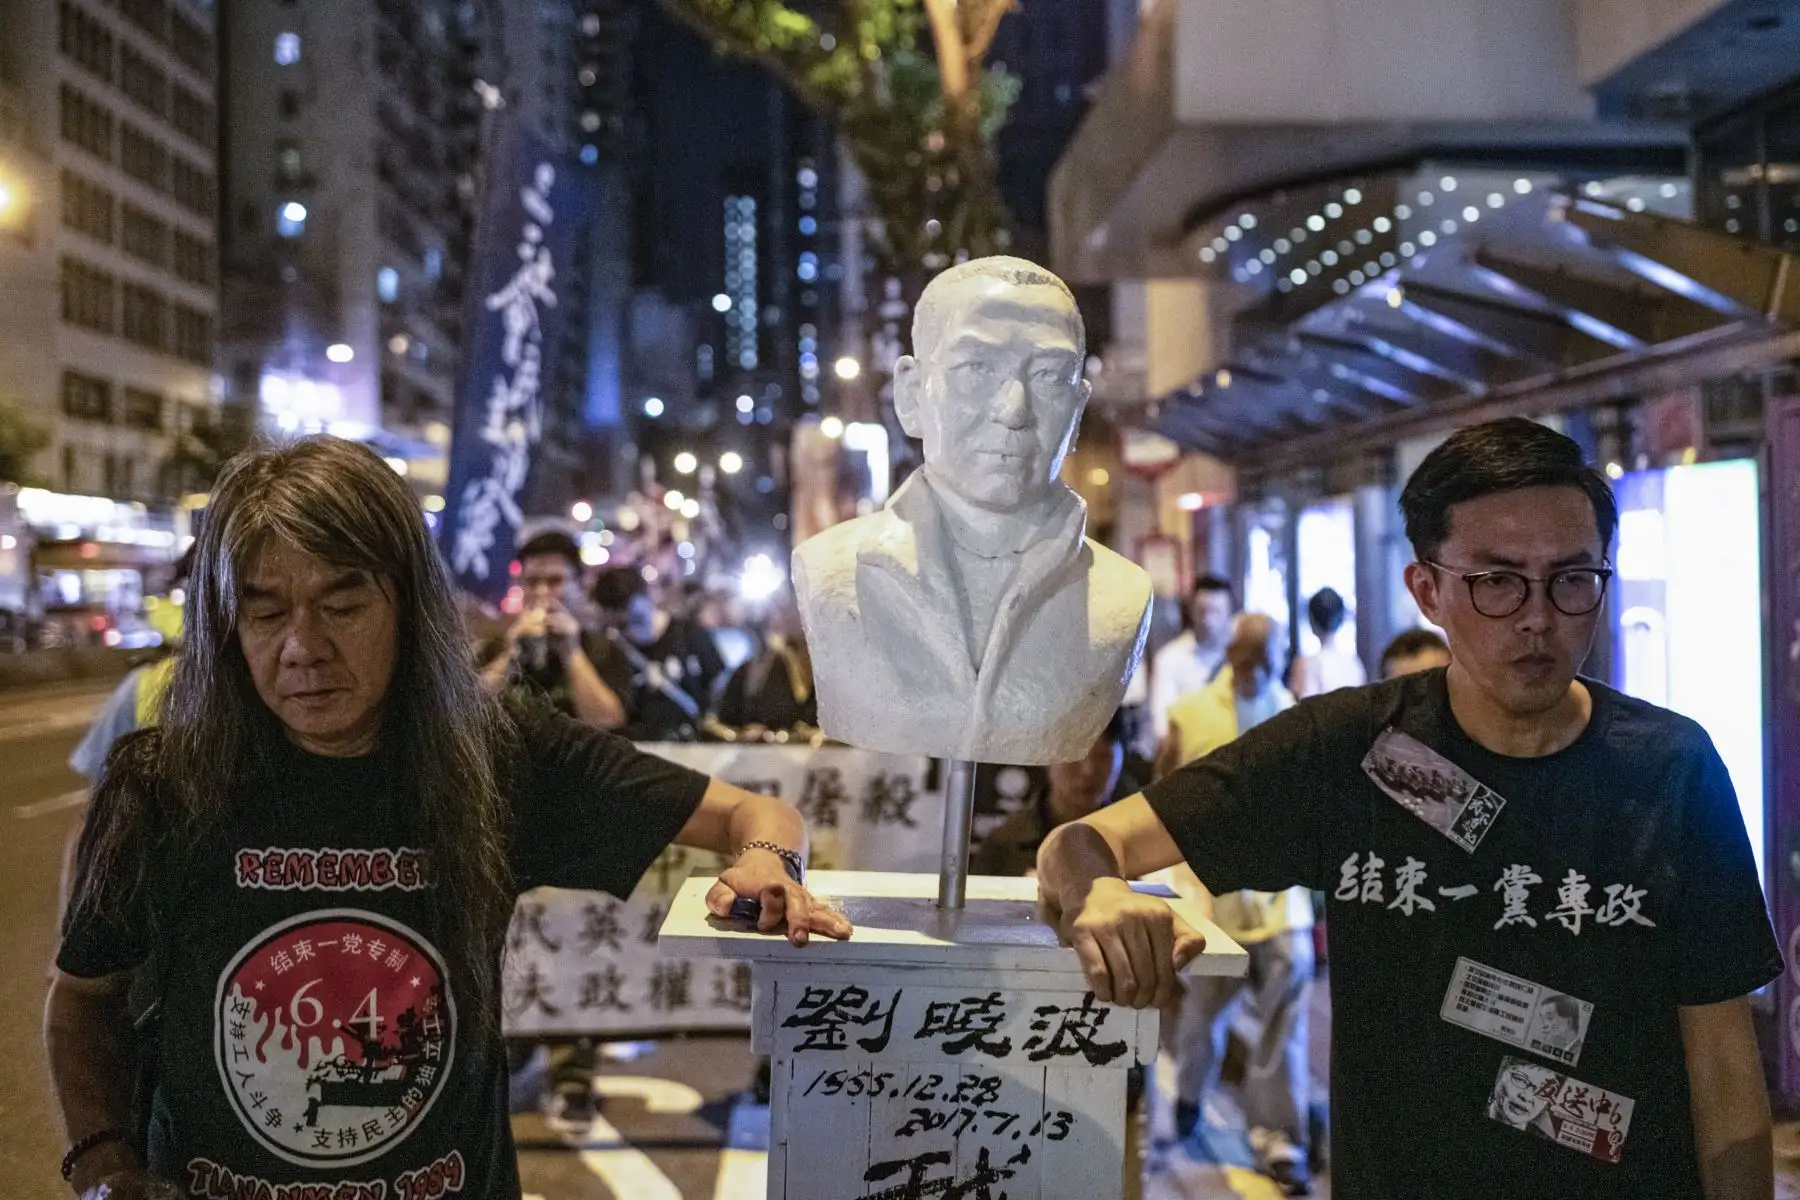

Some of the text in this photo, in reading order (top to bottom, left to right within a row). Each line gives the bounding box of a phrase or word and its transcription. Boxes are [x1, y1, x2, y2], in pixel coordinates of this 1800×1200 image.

[270, 932, 410, 976] 结束一党专制
[290, 978, 385, 1040] 6.4
[895, 1108, 1073, 1141] 2017.7.13
